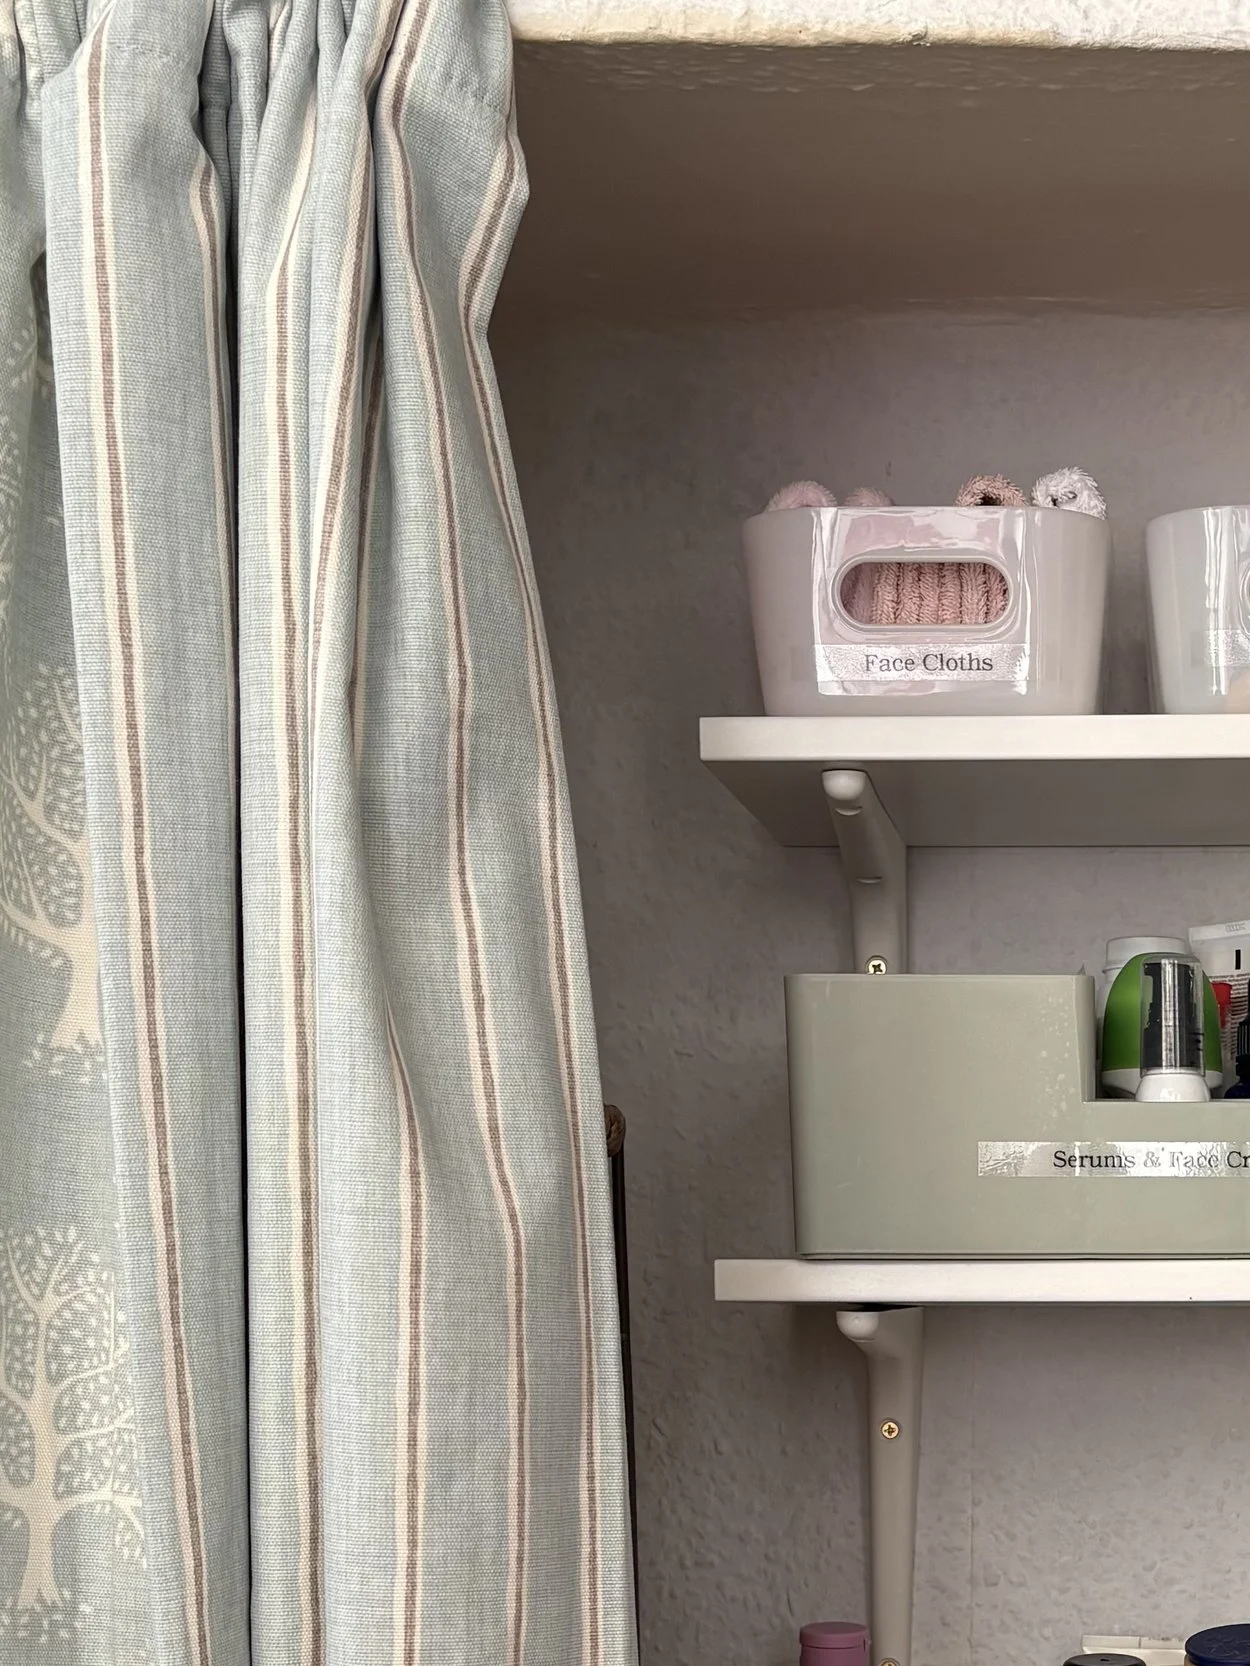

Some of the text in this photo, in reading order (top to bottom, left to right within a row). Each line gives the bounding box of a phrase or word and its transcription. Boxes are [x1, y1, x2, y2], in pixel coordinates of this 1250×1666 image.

[865, 652, 993, 672] Face Cloths
[1053, 1150, 1135, 1168] Serums
[1143, 1151, 1161, 1168] &
[1168, 1151, 1219, 1168] Face
